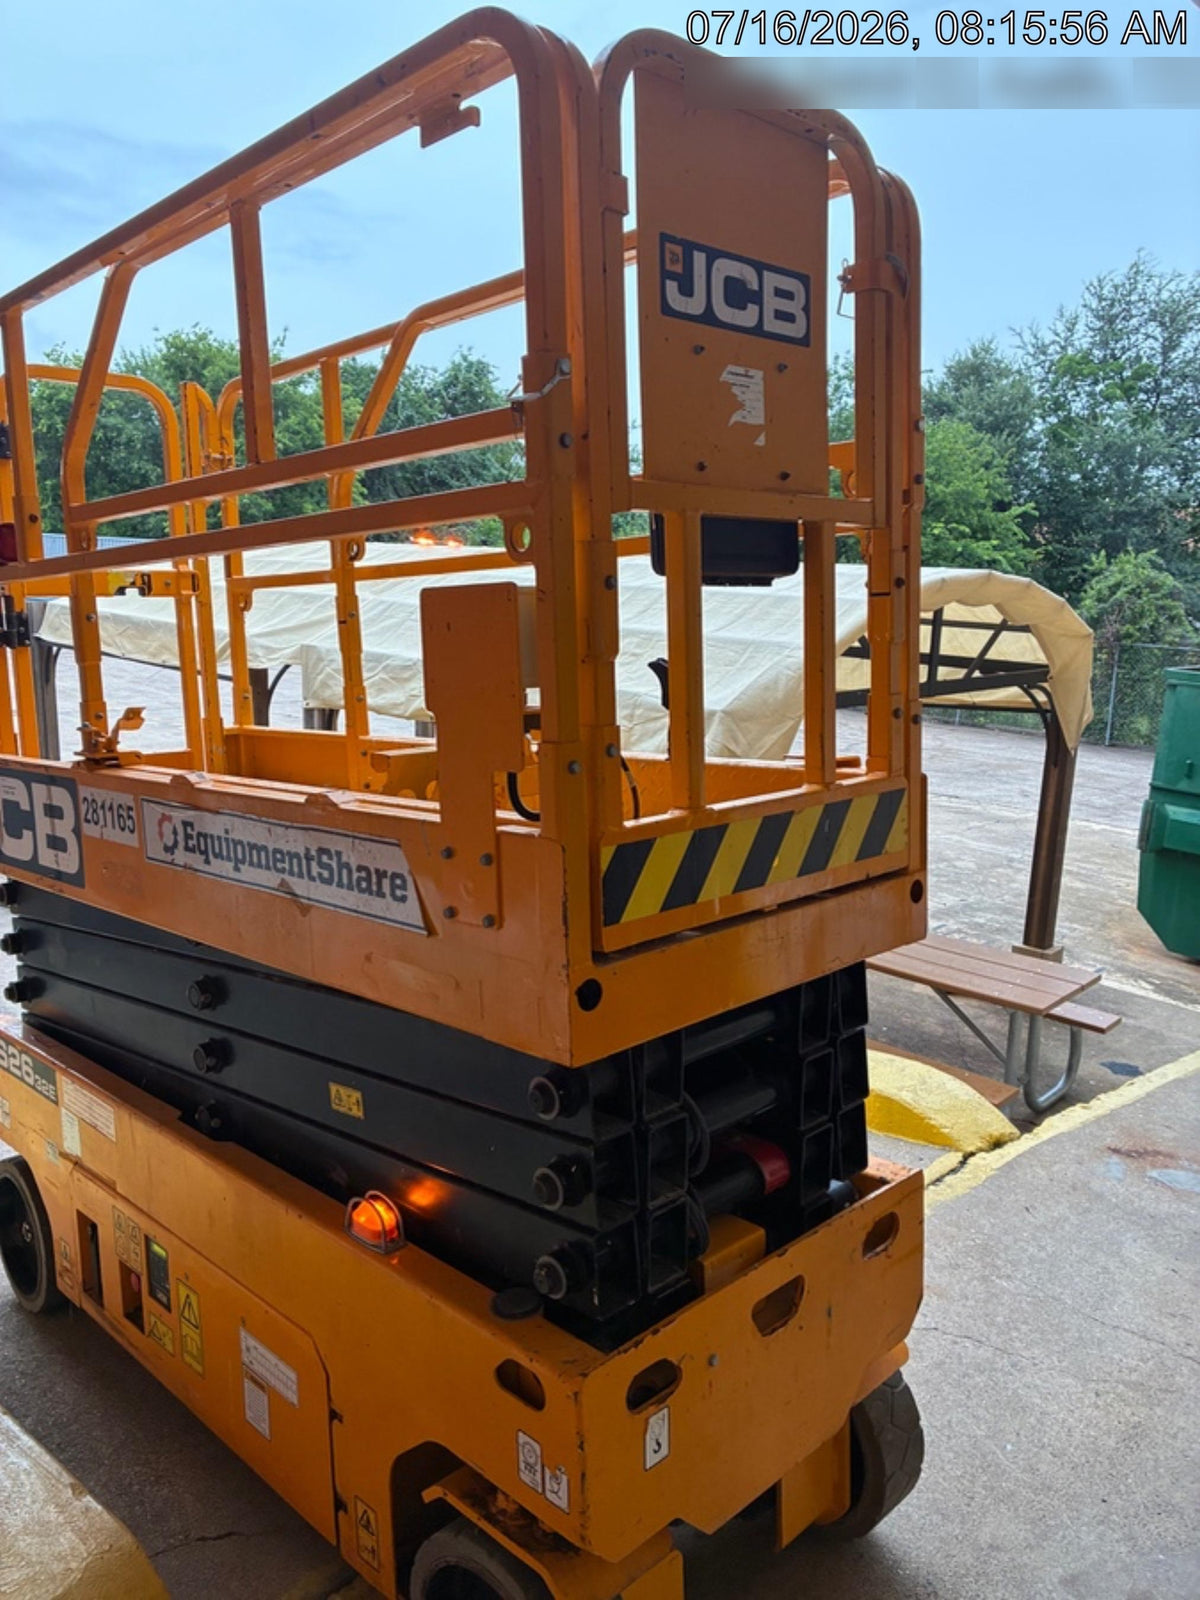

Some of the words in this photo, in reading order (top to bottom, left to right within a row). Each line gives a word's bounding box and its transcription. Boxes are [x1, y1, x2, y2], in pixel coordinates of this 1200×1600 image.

[665, 249, 808, 340] JCB
[82, 795, 136, 835] 281165
[181, 820, 409, 904] EquipmentShare
